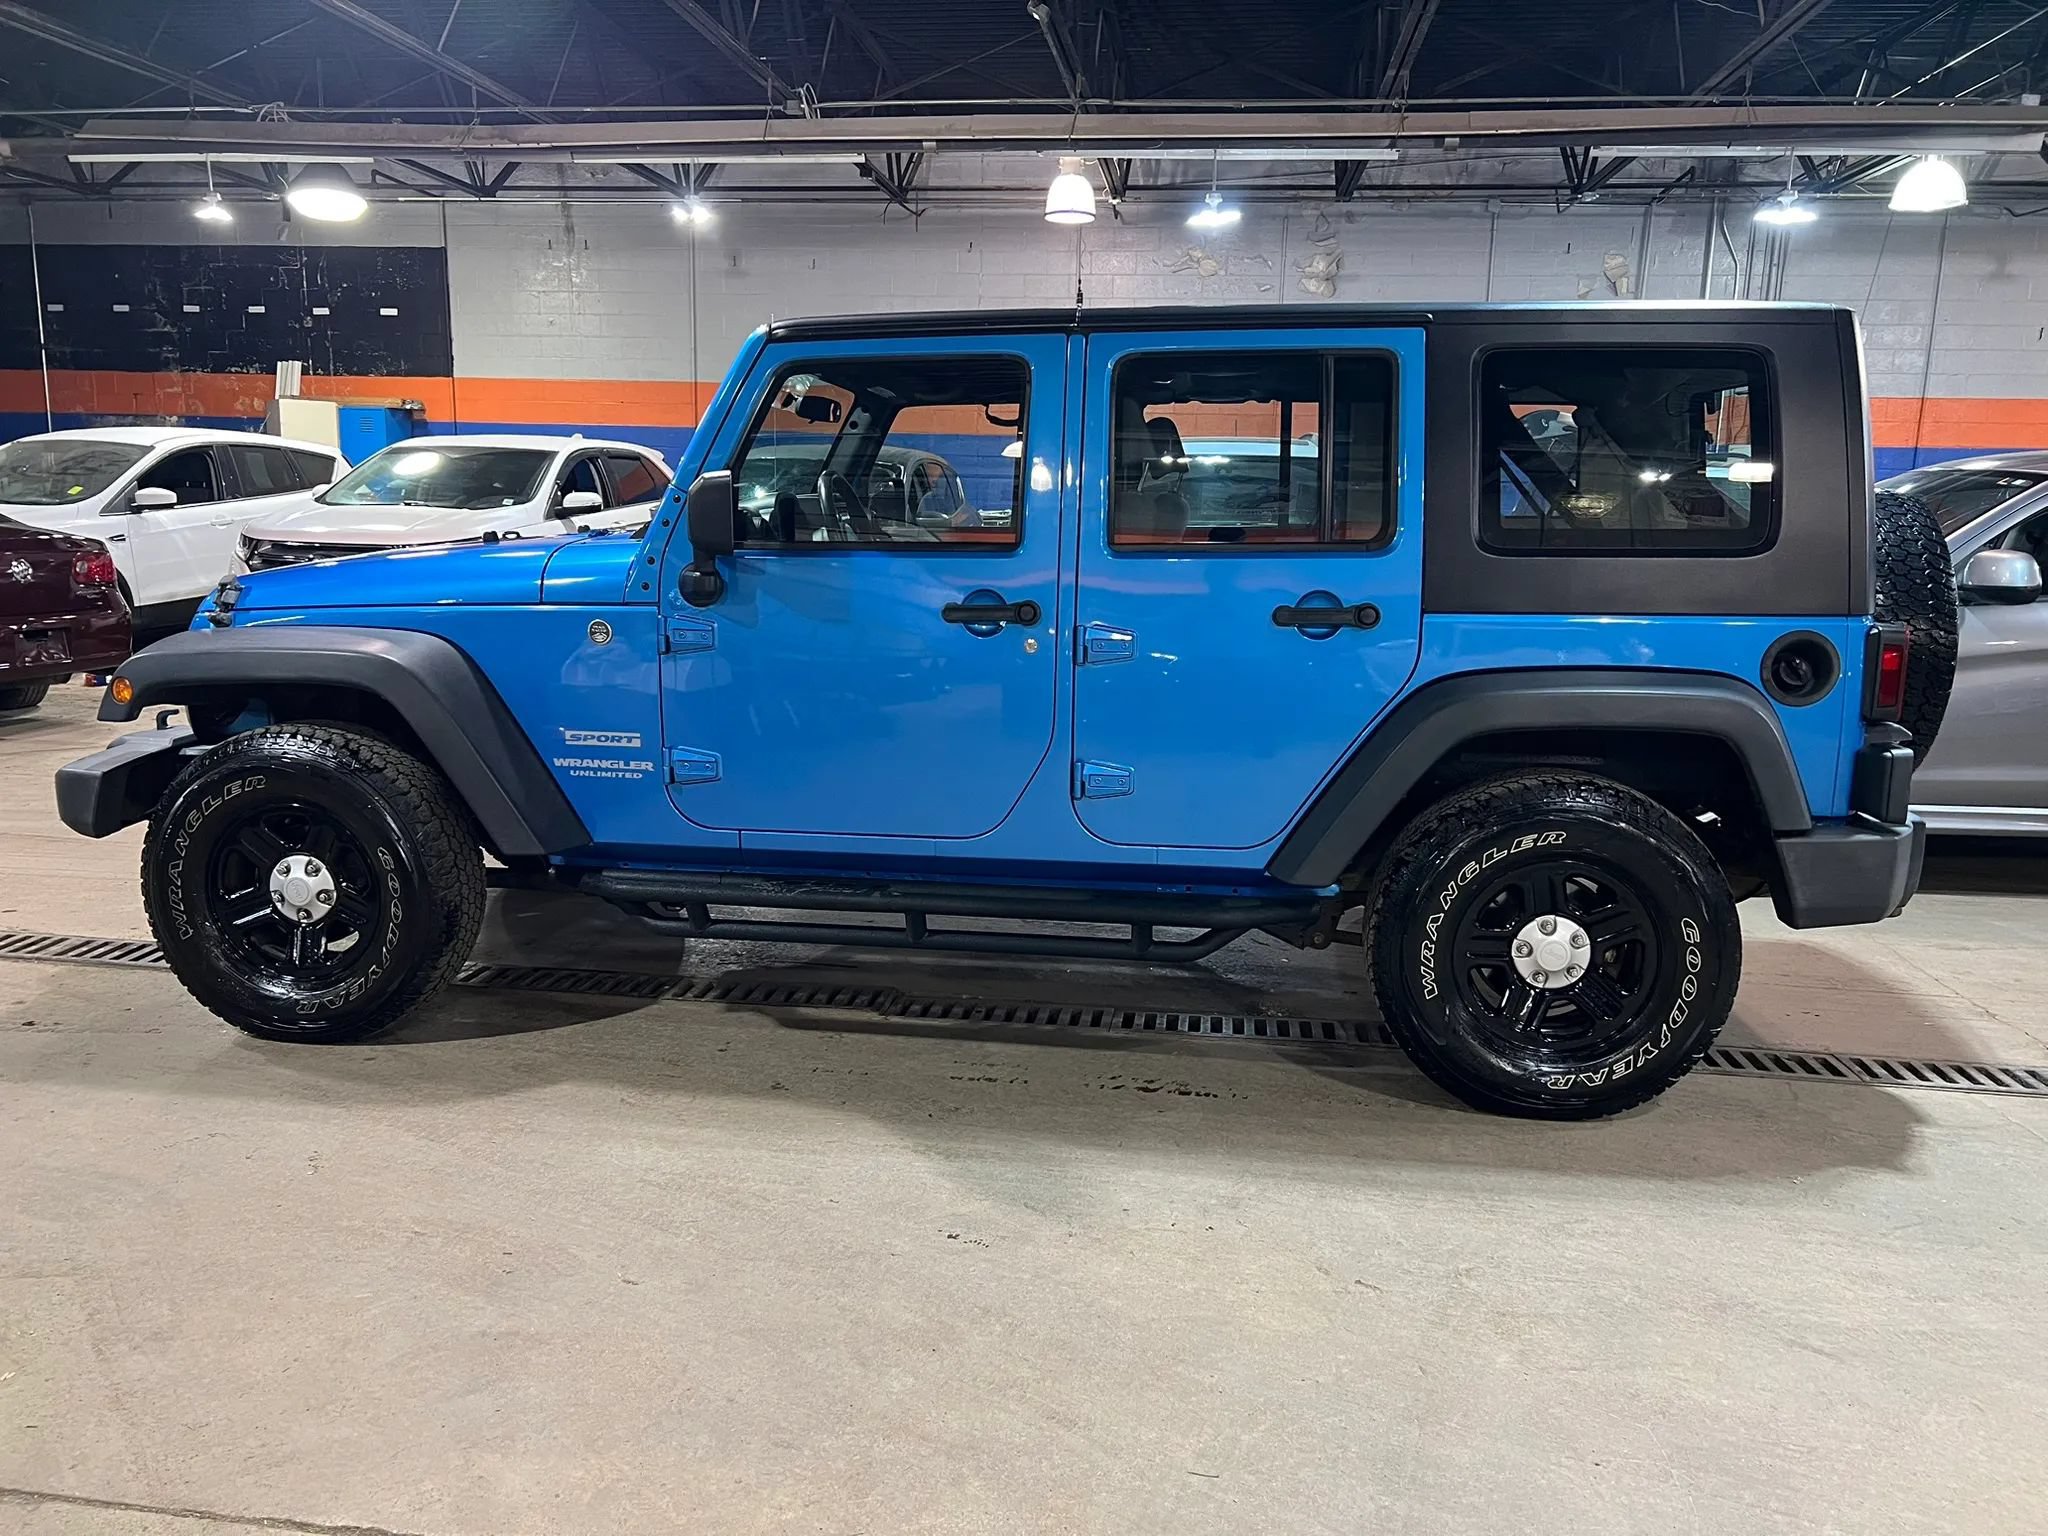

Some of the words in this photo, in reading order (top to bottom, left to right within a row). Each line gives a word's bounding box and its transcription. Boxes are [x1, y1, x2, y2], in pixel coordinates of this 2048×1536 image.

[553, 758, 655, 771] WRANGLER
[568, 734, 638, 744] SPORT
[570, 770, 643, 779] UNLIMITED
[168, 775, 266, 941] WRANGLER
[296, 847, 403, 1015] GOODYEAR
[1418, 830, 1567, 1000] WRANGLER
[1547, 918, 1702, 1090] GOODYEAR
